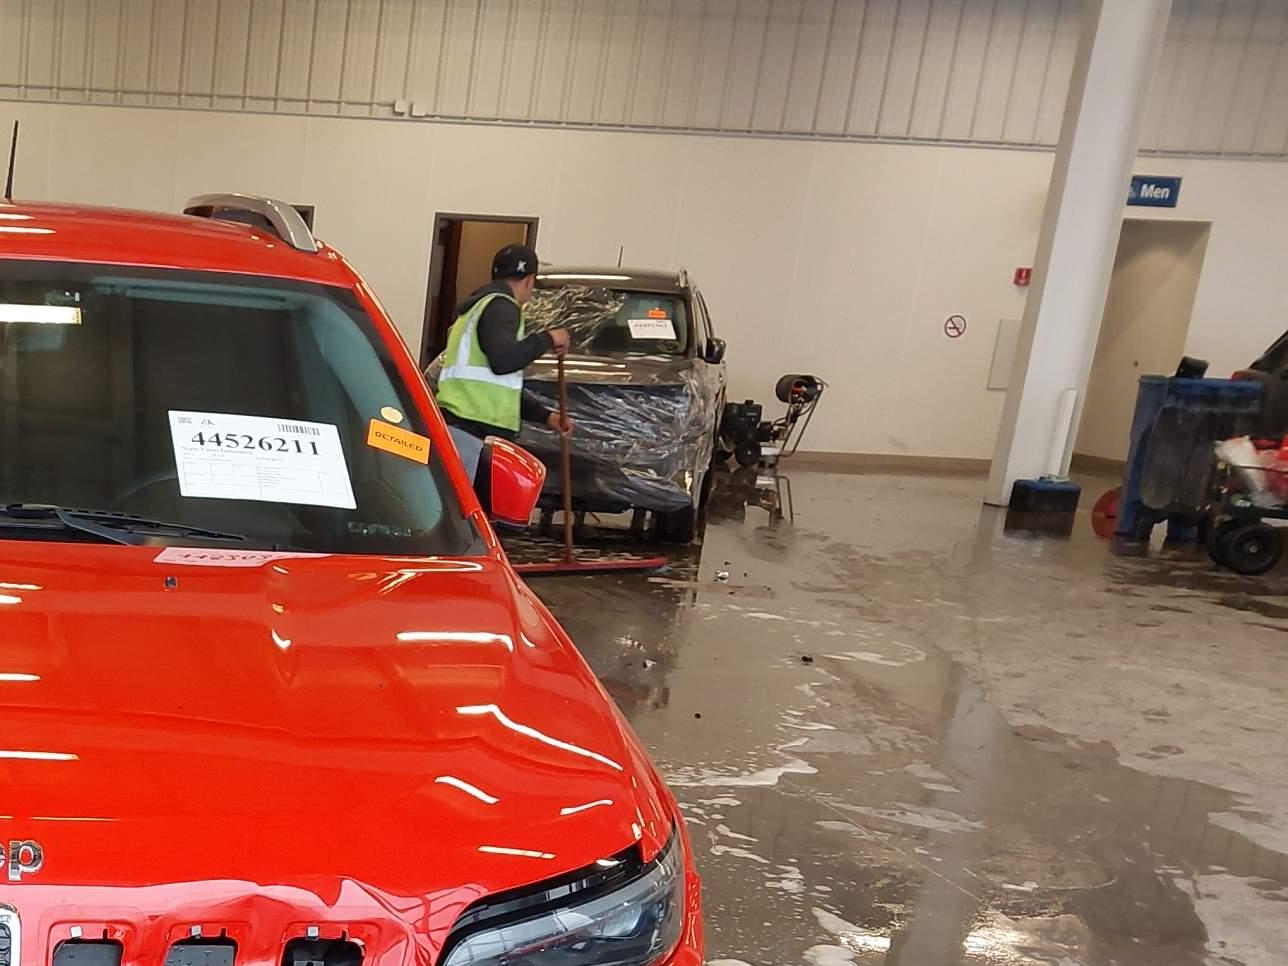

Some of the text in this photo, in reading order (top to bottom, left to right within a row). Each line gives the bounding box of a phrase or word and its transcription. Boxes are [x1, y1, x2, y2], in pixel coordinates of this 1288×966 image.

[1140, 183, 1170, 200] Men
[191, 431, 321, 456] 44526211
[375, 431, 423, 452] DETAILED
